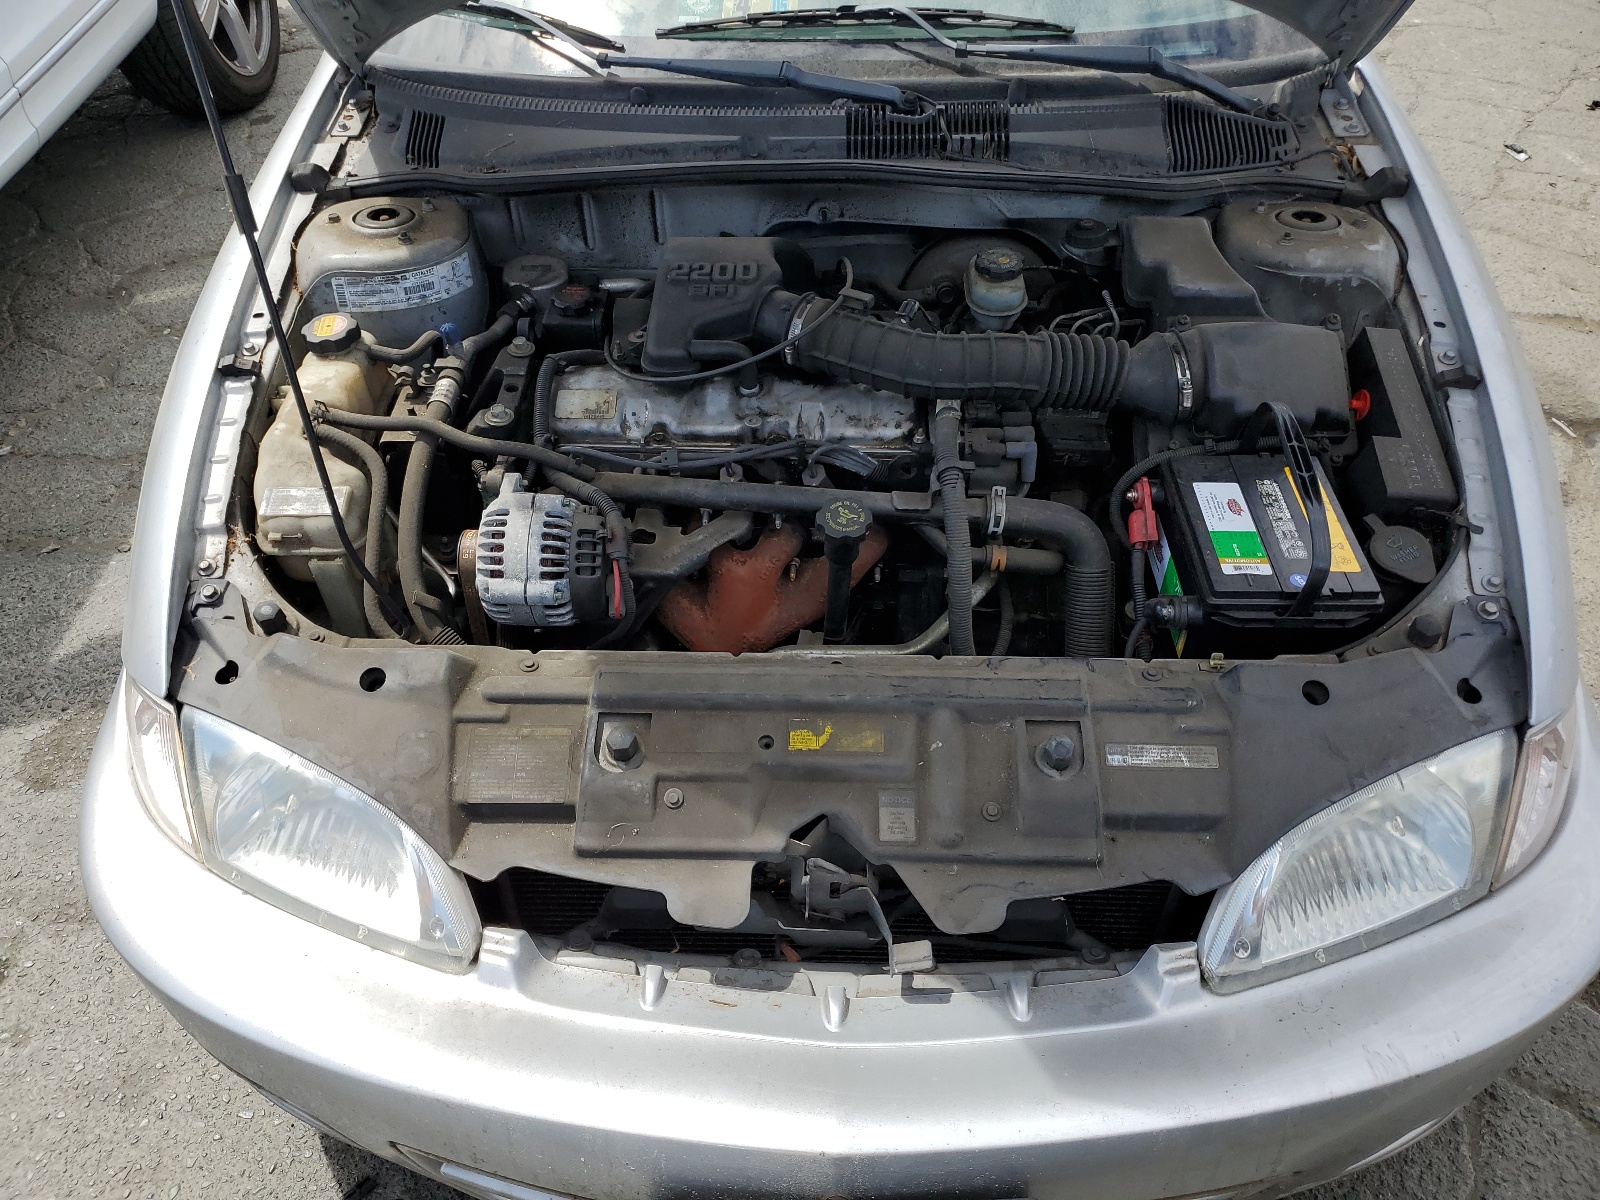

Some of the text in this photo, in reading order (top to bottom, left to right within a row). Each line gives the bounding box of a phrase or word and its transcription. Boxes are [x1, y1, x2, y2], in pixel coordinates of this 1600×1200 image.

[411, 267, 435, 278] CATALYST
[666, 261, 758, 283] 2200
[1390, 545, 1419, 561] WASHER
